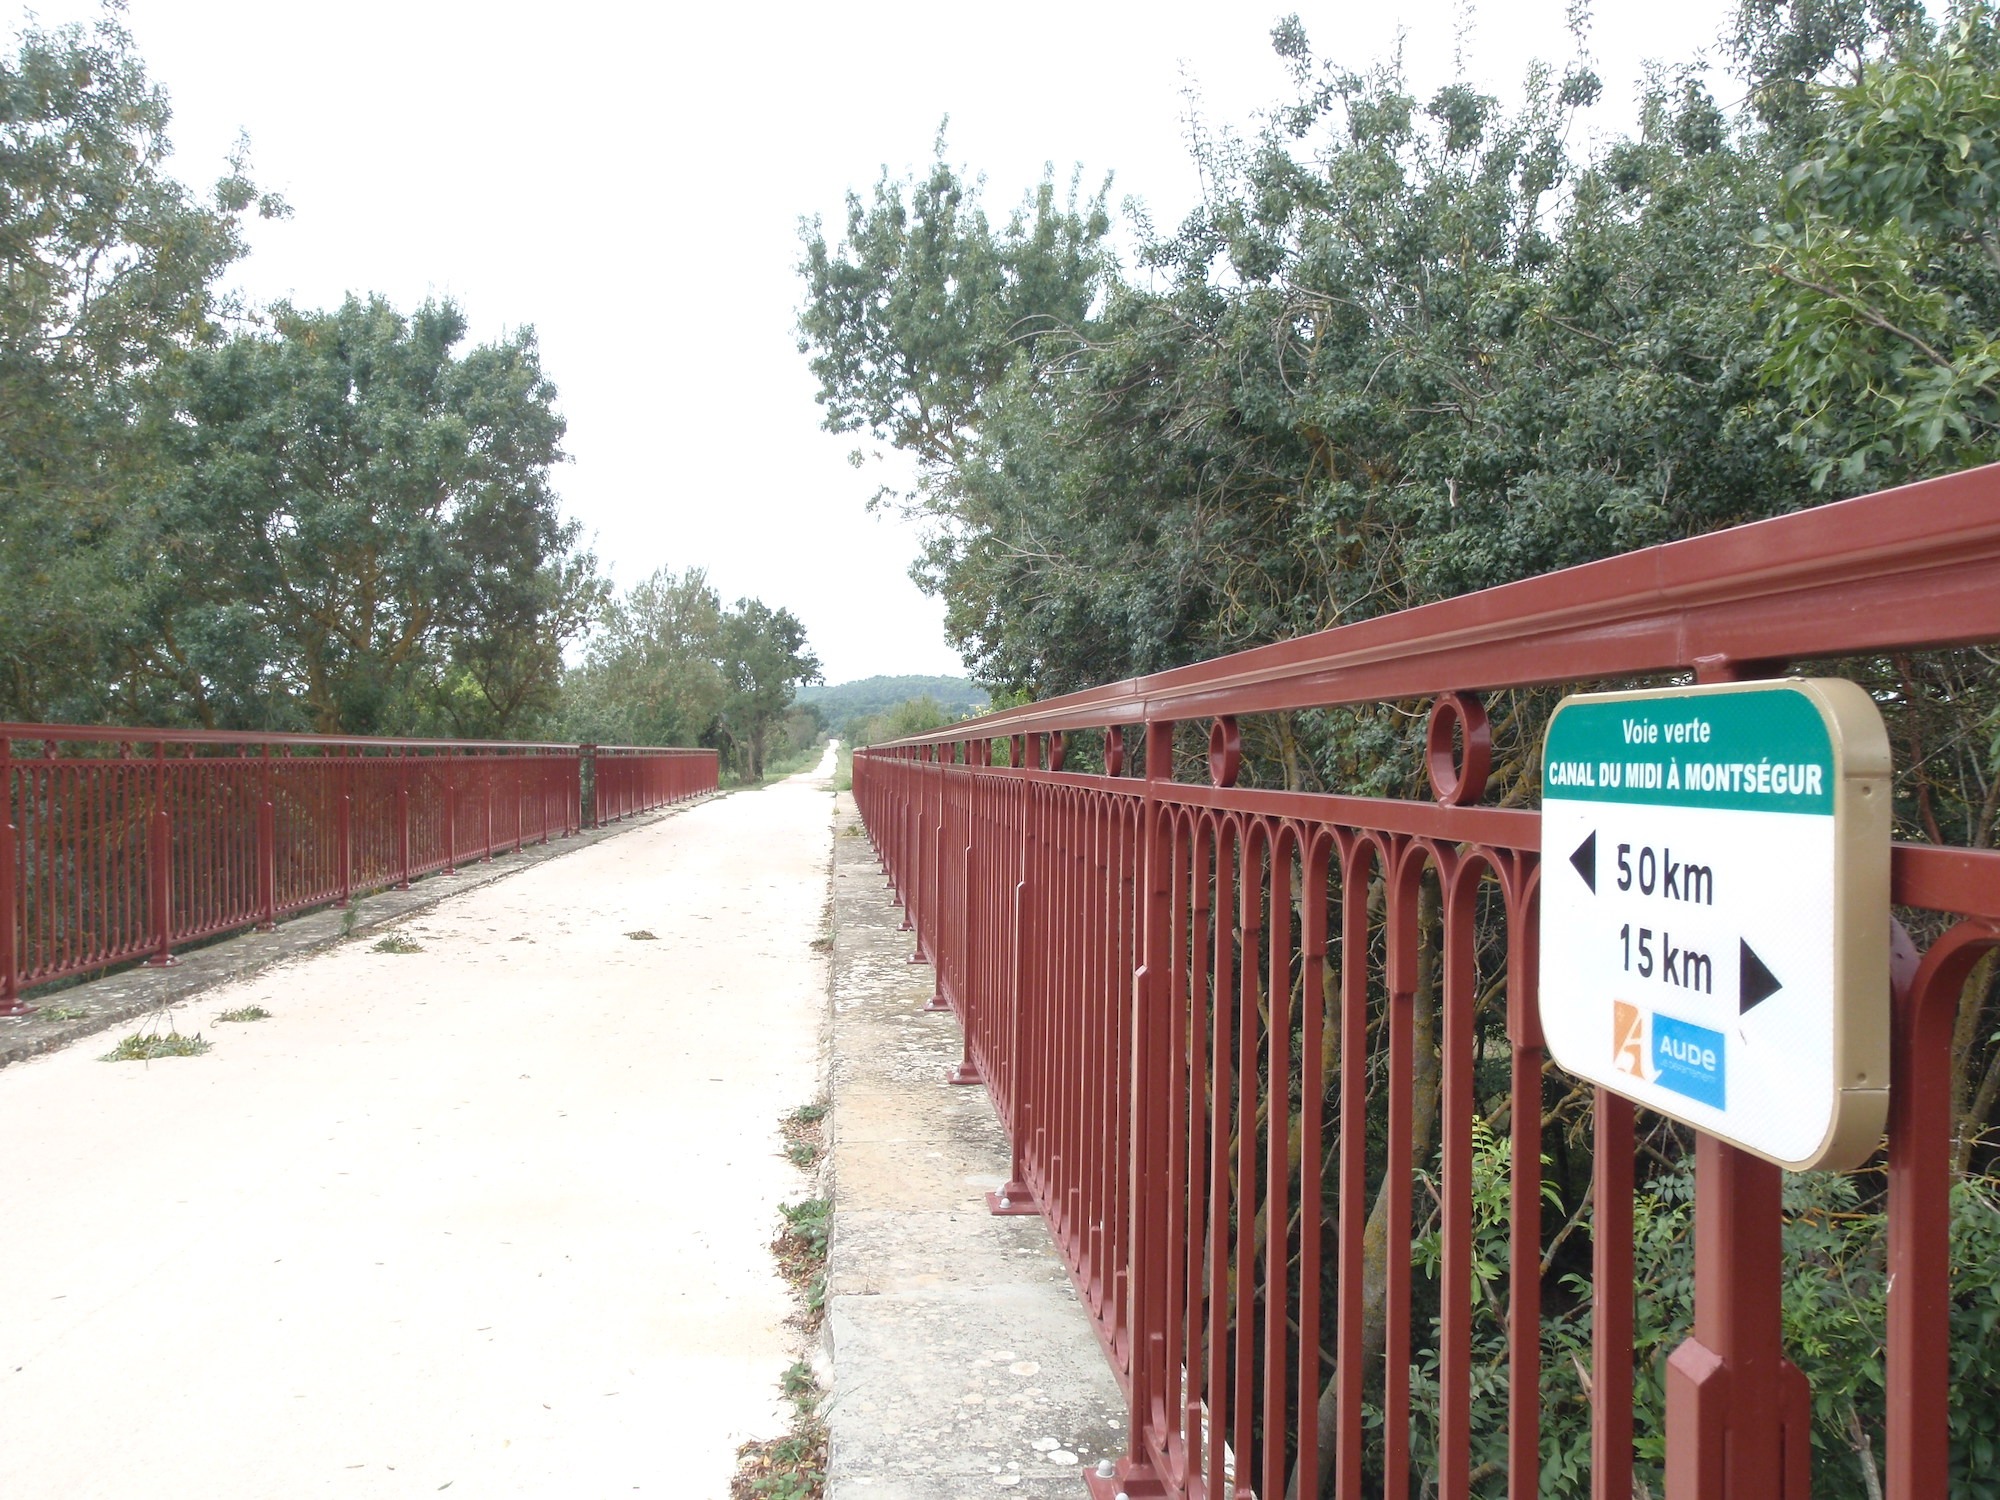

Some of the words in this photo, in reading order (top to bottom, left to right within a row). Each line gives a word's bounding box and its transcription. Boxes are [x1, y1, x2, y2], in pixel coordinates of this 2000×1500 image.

[1622, 718, 1658, 744] Voie
[1664, 717, 1710, 744] verte
[1549, 761, 1595, 787] CANAL
[1599, 762, 1622, 788] DU
[1625, 762, 1662, 790] MIDI
[1667, 757, 1681, 790] À
[1685, 757, 1823, 796] MONTSÉGUR
